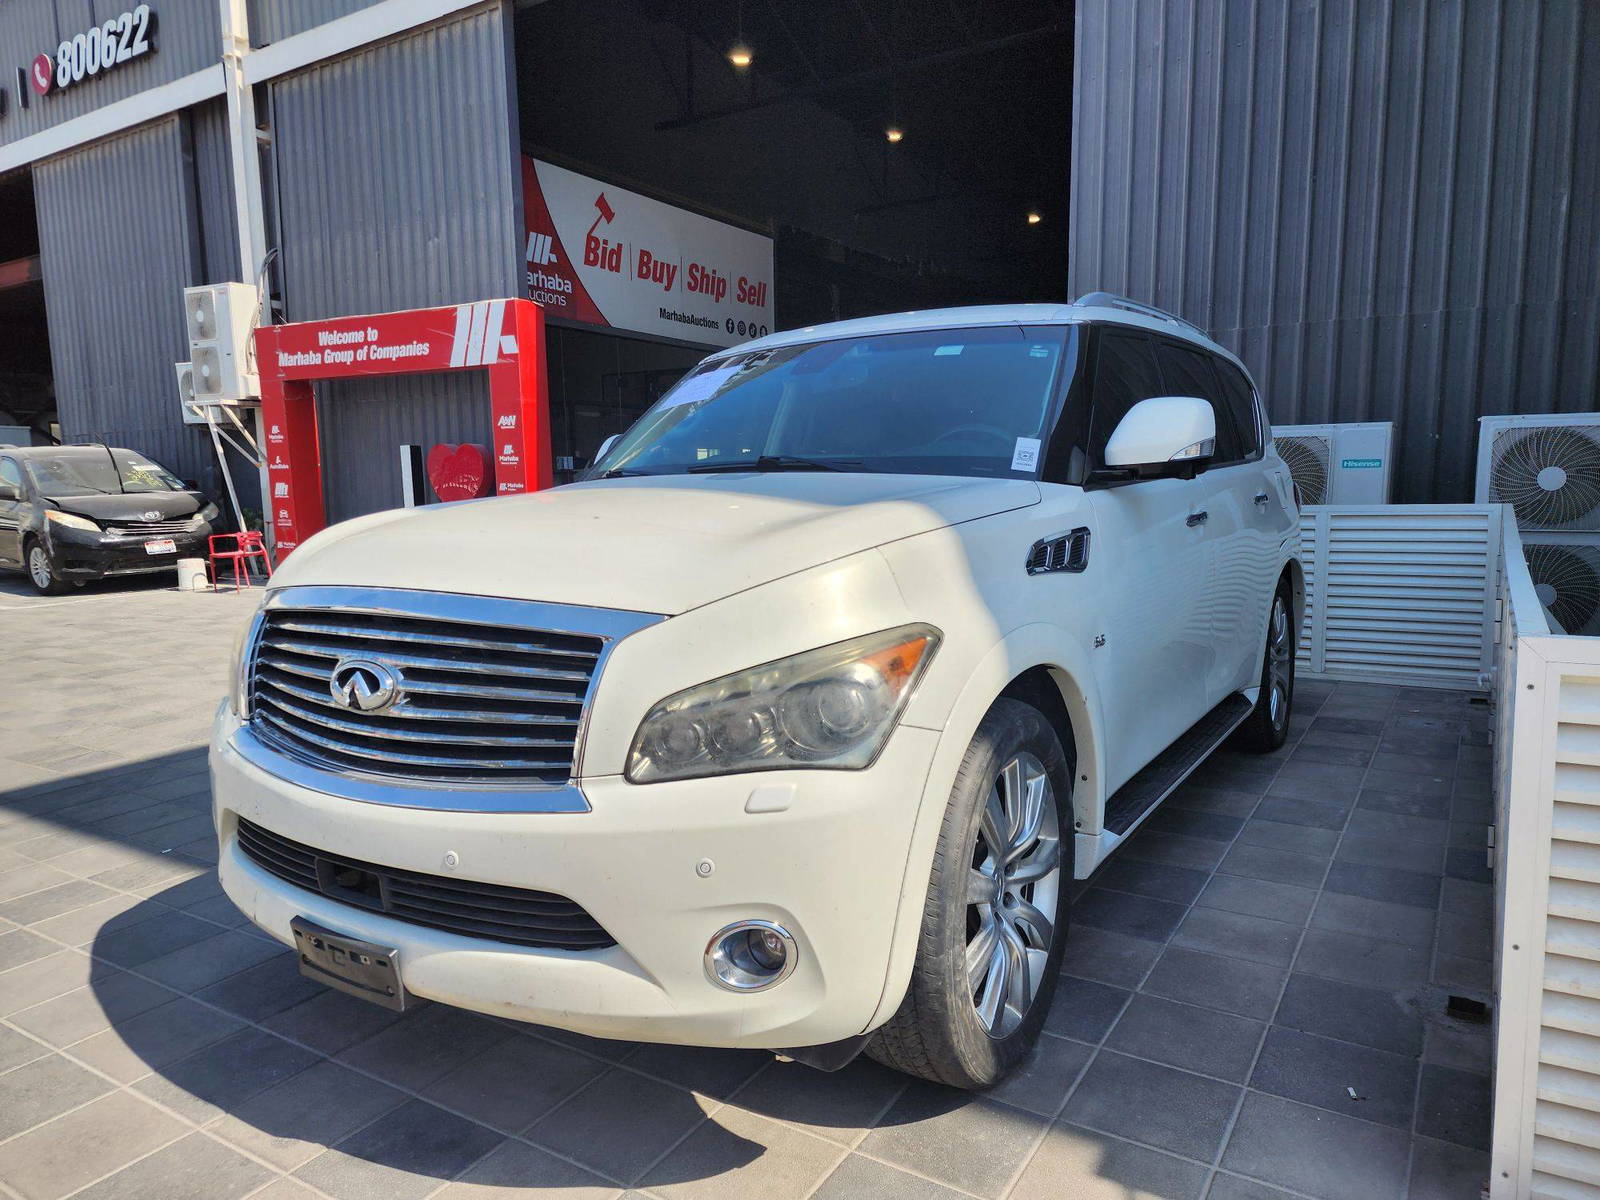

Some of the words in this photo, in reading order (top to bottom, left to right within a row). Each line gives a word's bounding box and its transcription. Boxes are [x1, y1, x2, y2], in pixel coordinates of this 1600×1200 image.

[57, 4, 150, 88] 800622
[527, 270, 572, 294] arhaba
[584, 235, 623, 273] Bid
[637, 249, 677, 292] Buy
[687, 262, 727, 303] Ship
[737, 276, 767, 307] Sell
[528, 289, 567, 306] uctions
[659, 307, 720, 330] MarhabaAuctions
[318, 330, 364, 346] Welcome
[367, 327, 378, 341] to
[278, 350, 321, 367] Marhaba
[324, 349, 353, 365] Group
[356, 346, 367, 361] of
[370, 340, 430, 361] Companies
